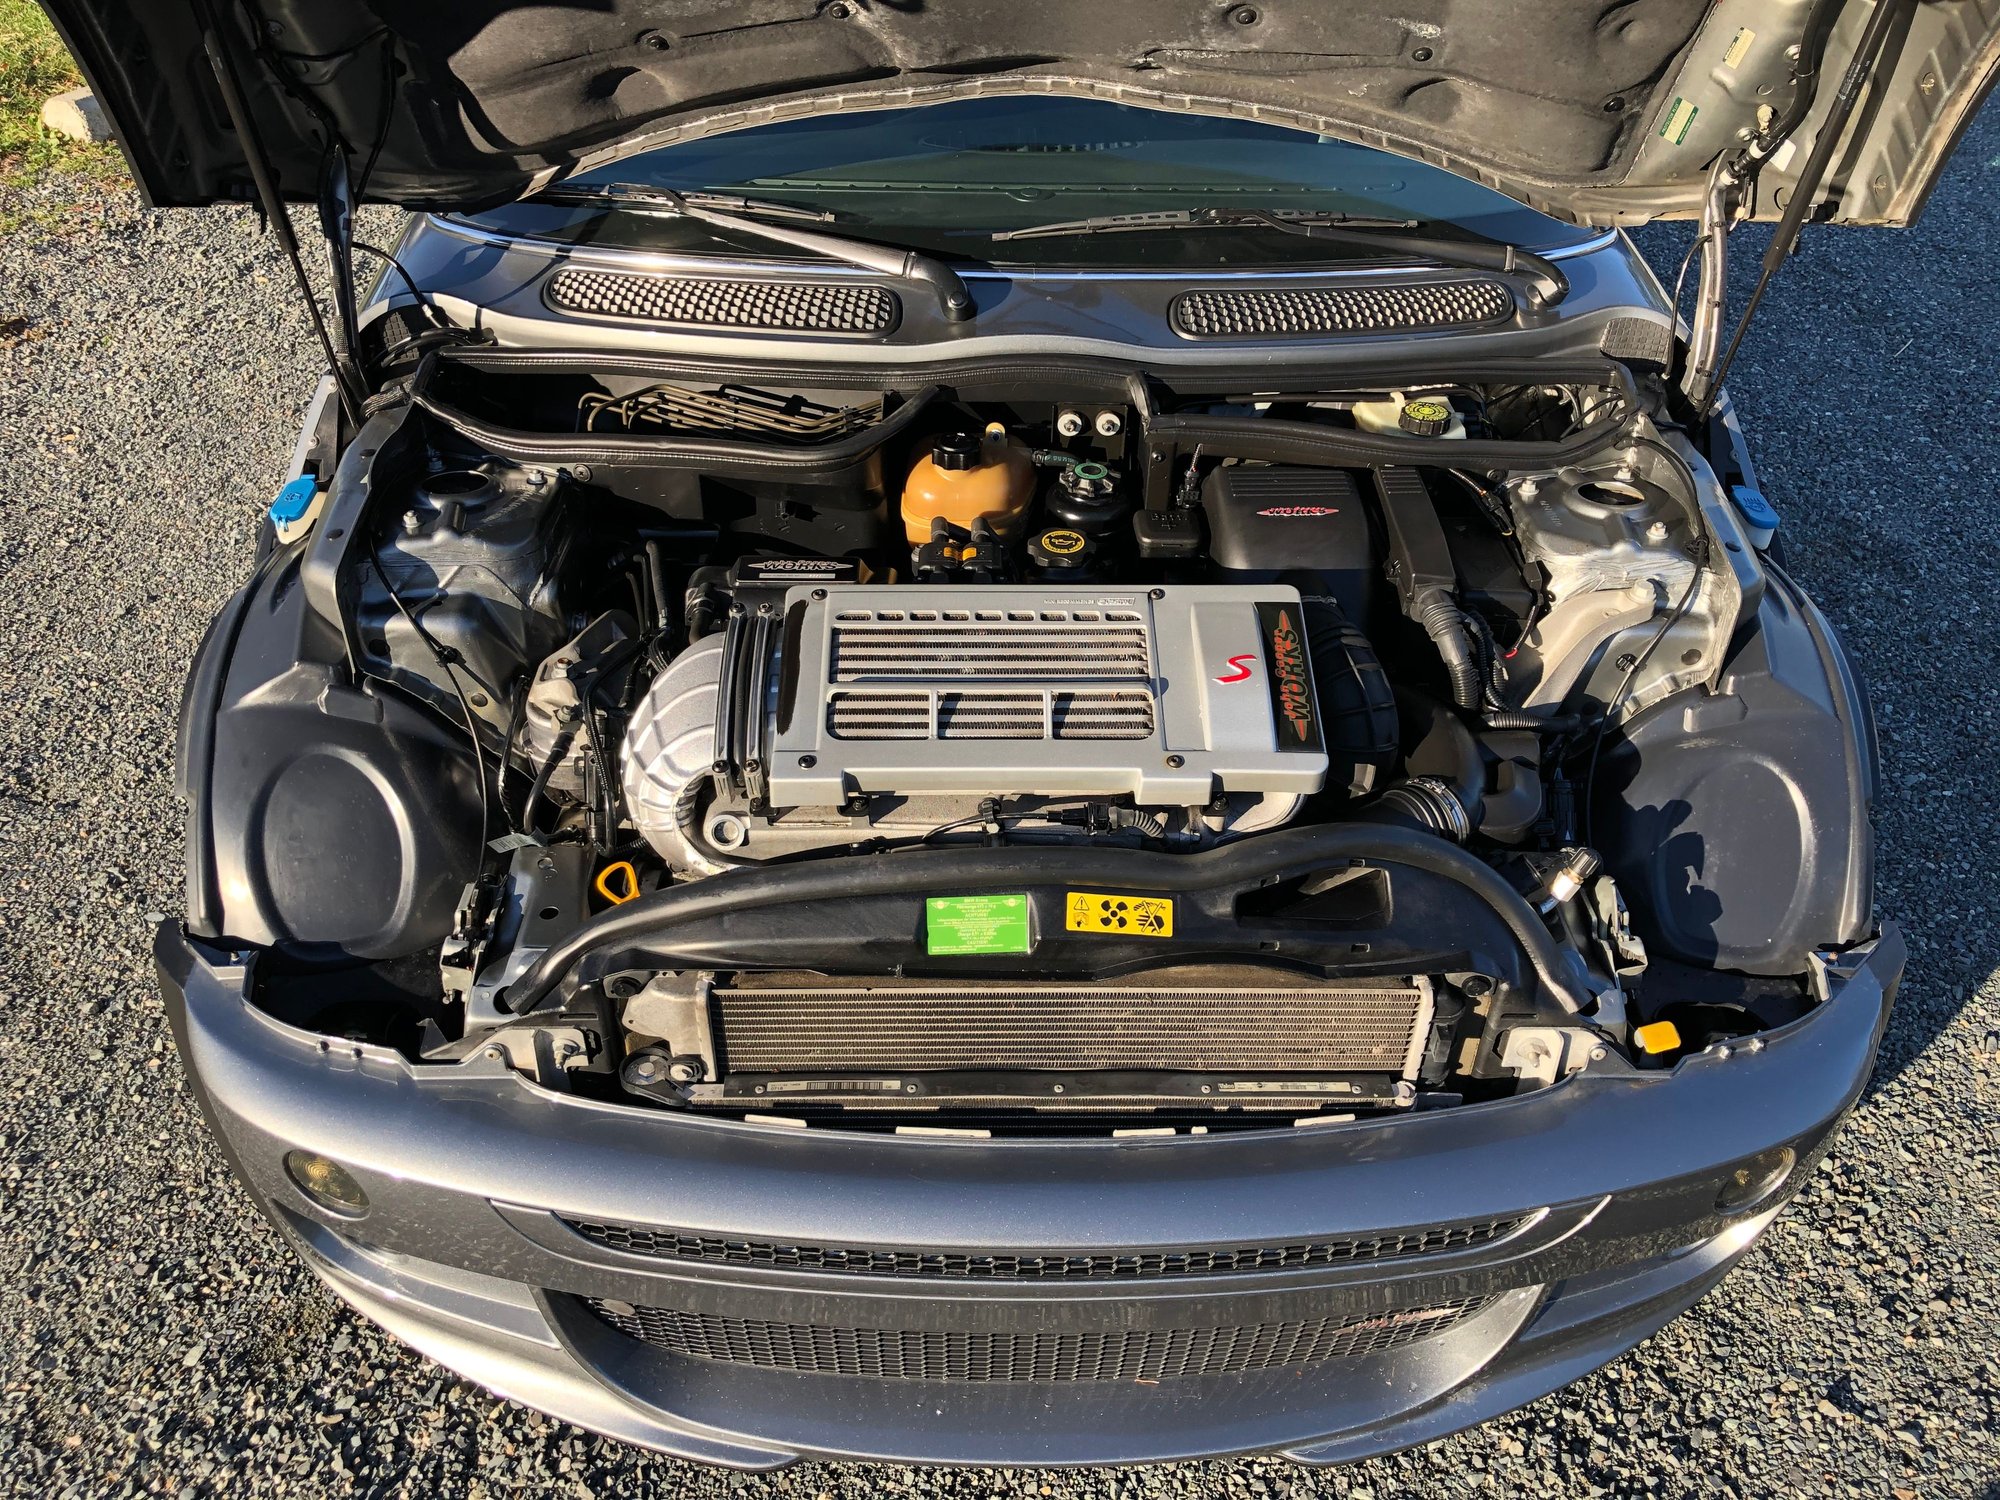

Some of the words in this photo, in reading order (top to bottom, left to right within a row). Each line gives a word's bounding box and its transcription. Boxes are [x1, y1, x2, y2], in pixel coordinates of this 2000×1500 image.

[763, 560, 838, 571] WORKS
[1212, 654, 1257, 685] S
[1274, 628, 1287, 678] Cooper
[1281, 628, 1311, 721] WORKS
[1280, 685, 1296, 719] John
